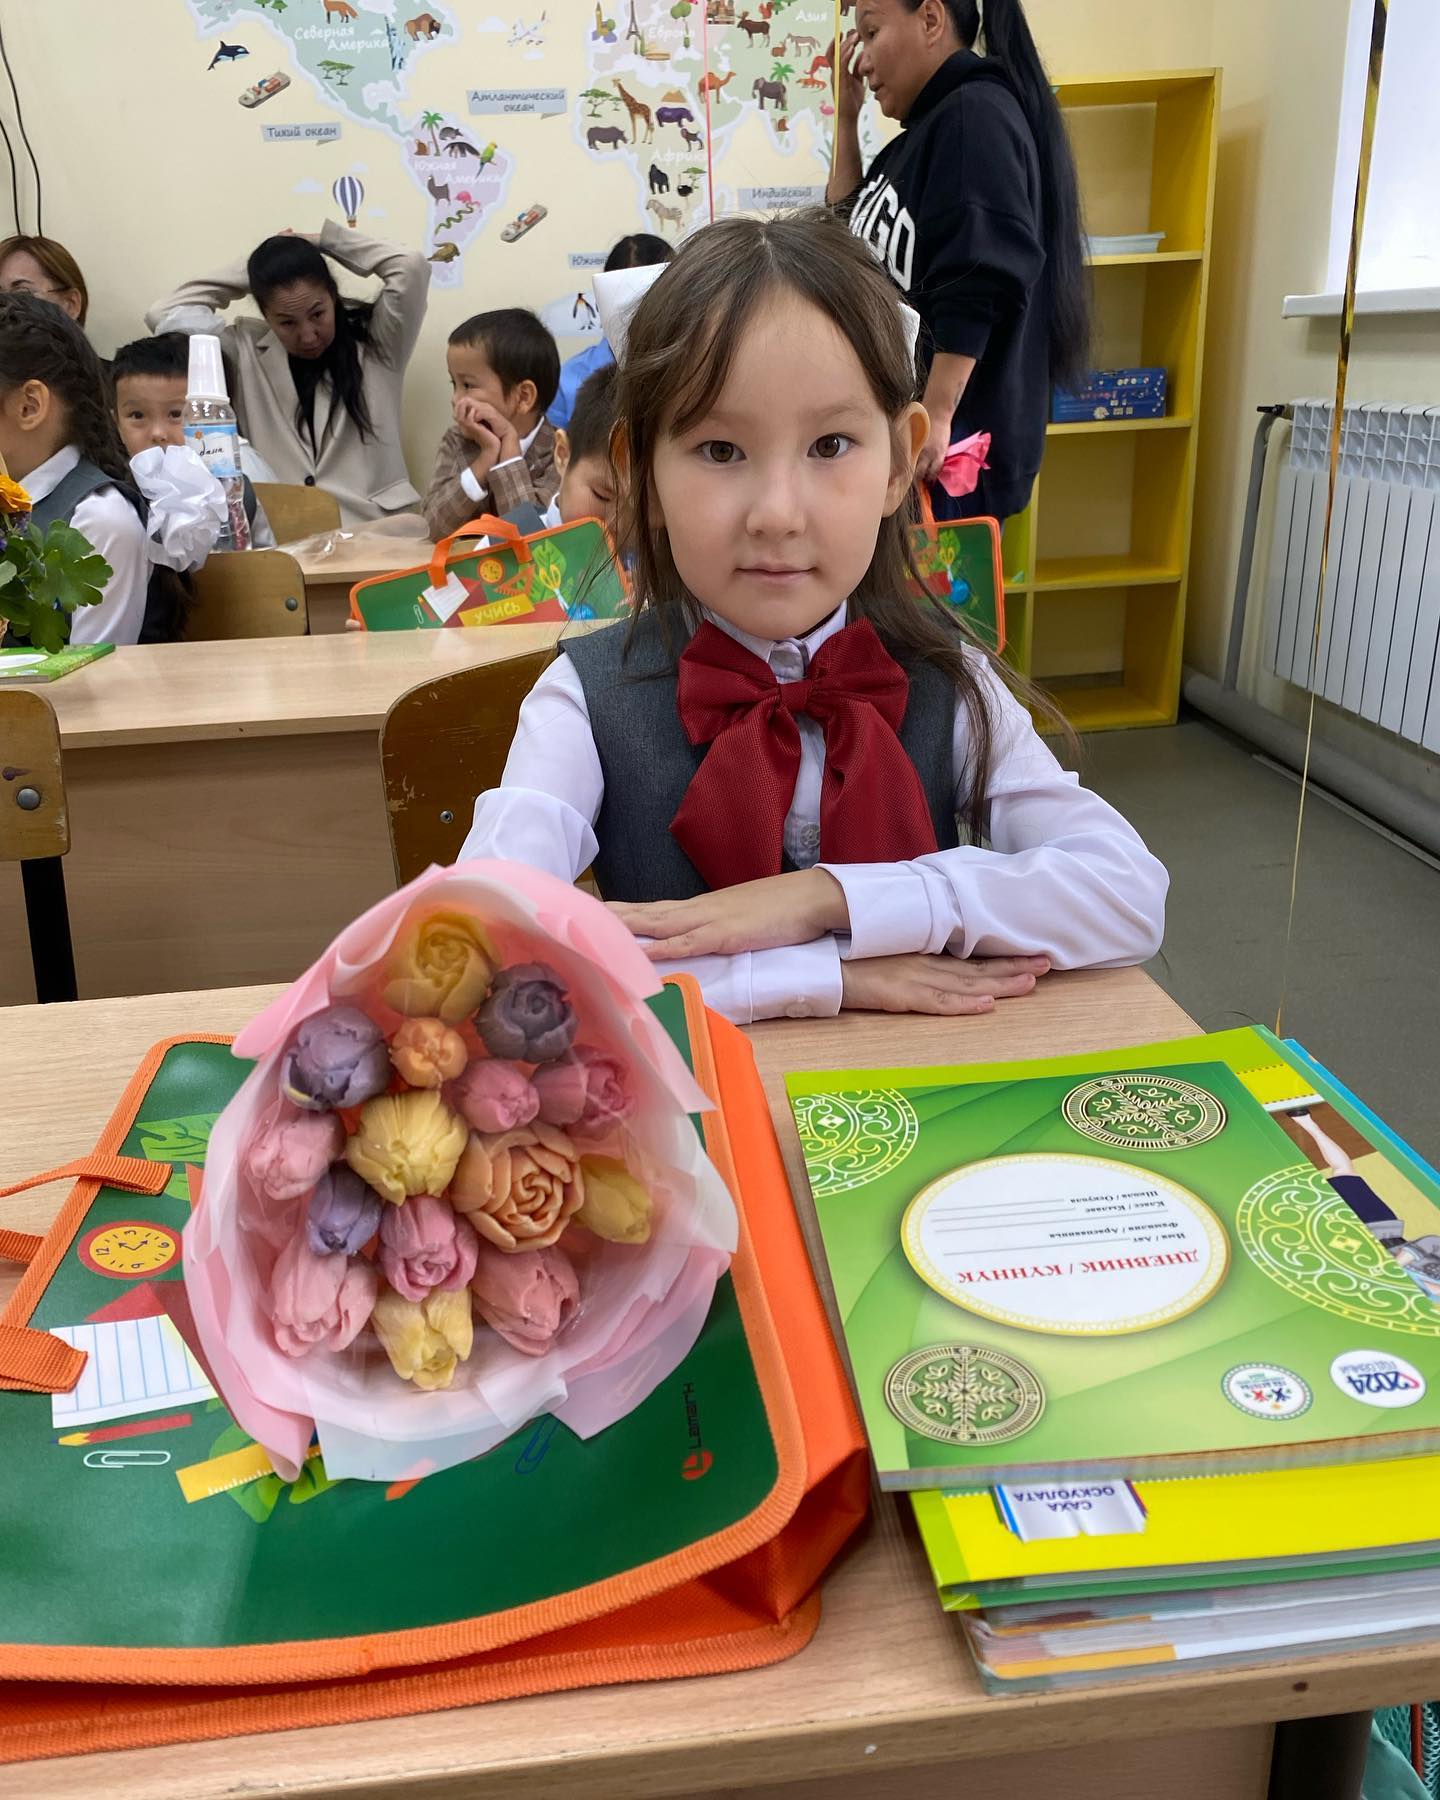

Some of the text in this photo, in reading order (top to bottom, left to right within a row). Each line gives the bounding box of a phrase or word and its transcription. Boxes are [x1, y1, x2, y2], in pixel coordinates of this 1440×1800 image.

[294, 24, 356, 41] Северная
[327, 38, 390, 53] Америка
[471, 90, 565, 101] Атлантический
[503, 103, 536, 112] океан
[266, 126, 337, 138] Тихий океан
[1081, 1249, 1199, 1274] ДНЕВНИК
[1346, 1371, 1410, 1395] 2024
[1013, 1486, 1115, 1502] ОСКУОЛАТА
[1046, 1500, 1093, 1512] САХА
